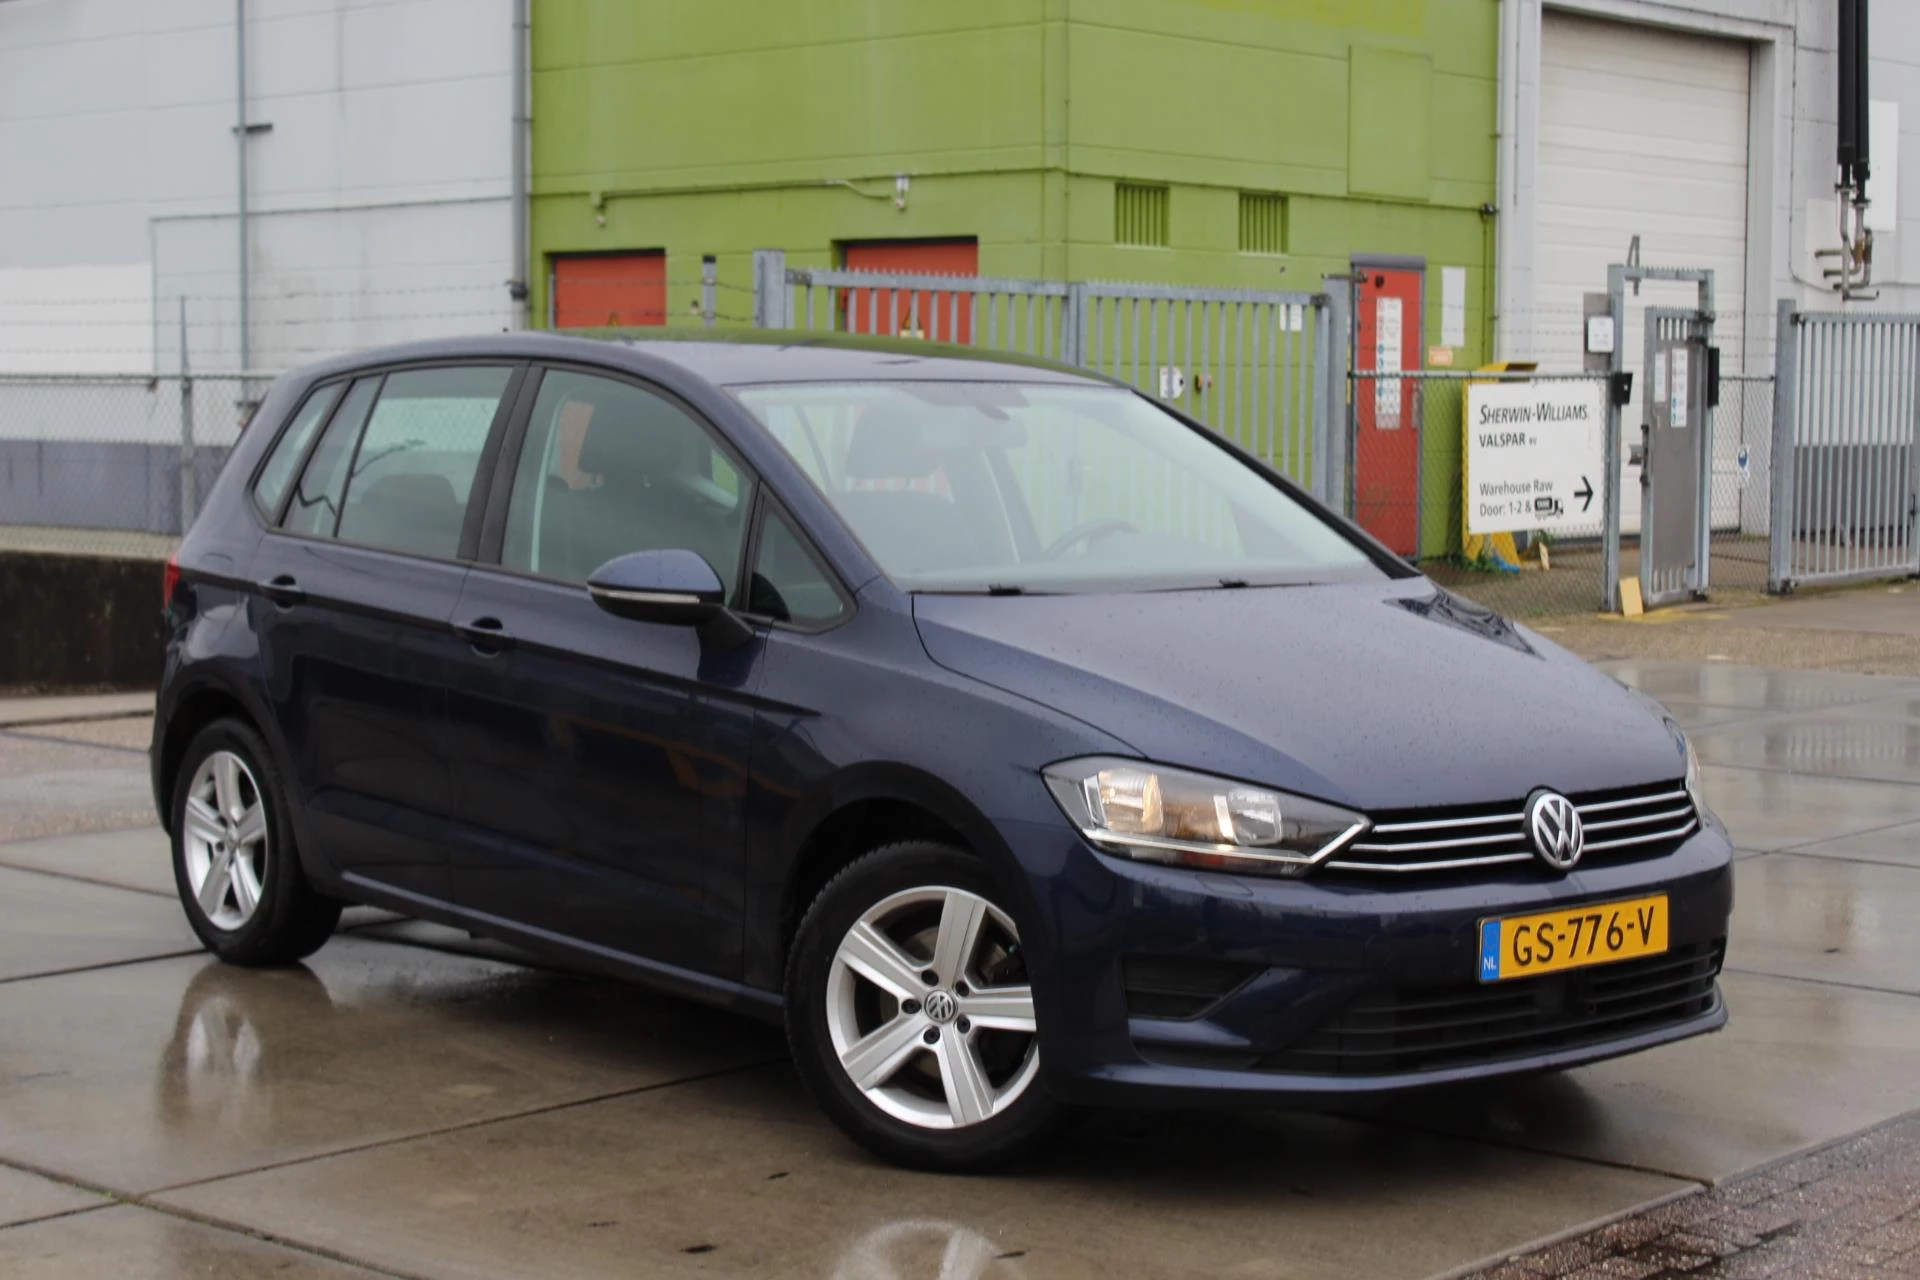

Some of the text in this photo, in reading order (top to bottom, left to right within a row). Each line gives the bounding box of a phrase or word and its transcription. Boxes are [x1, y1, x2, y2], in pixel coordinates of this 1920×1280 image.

[1479, 402, 1588, 425] SHERWIN-WILLIAMS
[1479, 432, 1525, 448] VALSPAR
[1479, 479, 1553, 496] Warehouse Raw
[1479, 501, 1506, 517] Door:
[1508, 502, 1522, 514] 1-2
[1512, 905, 1655, 967] GS-776-V
[1483, 956, 1496, 970] NL
